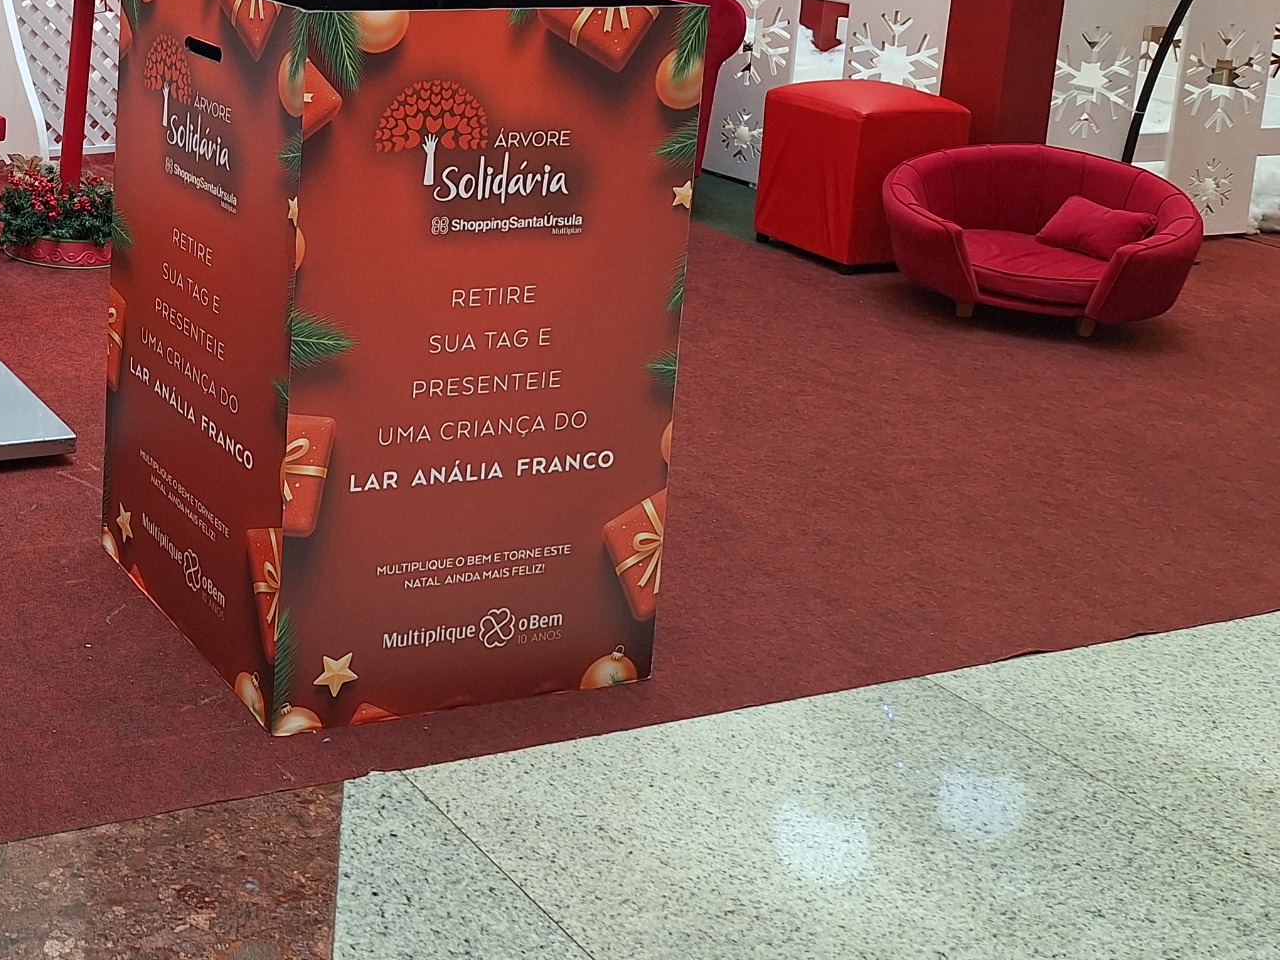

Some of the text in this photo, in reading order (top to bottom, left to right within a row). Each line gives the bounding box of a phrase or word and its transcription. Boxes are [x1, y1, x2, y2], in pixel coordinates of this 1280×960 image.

[193, 91, 232, 124] ÁRVORE
[166, 111, 231, 172] Solidária
[493, 128, 571, 148] ÁRVORE
[173, 163, 237, 206] ShoppingSantaÚrsula
[433, 151, 569, 204] Solidária
[451, 211, 583, 233] ShoppingSantaÚrsula
[172, 227, 213, 267] RETIRE
[162, 262, 220, 314] SUA TAG E
[451, 285, 537, 307] RETIRE
[155, 297, 225, 361] PRESENTEIE
[428, 327, 552, 354] SUA TAG E
[141, 326, 238, 414] UMA CRIANÇA DO
[412, 369, 562, 399] PRESENTEIE
[130, 356, 254, 470] LAR ANÁLIA FRANCO
[378, 410, 587, 446] UMA CRIANÇA DO
[349, 450, 615, 493] LAR ANÁLIA FRANCO
[140, 448, 230, 539] MULTIPLIQUE O BEM E TORNE ESTE
[150, 473, 167, 496] NATAL
[167, 491, 185, 513] AINDA
[185, 508, 198, 526] MAIS
[142, 512, 183, 564] Multiplique
[376, 544, 571, 576] MULTIPLIQUE O BEM E TORNE ESTE
[404, 563, 546, 589] NATAL AINDA MAIS FELIZ!
[382, 624, 476, 649] Multiplique
[517, 629, 562, 645] 10 ANOS
